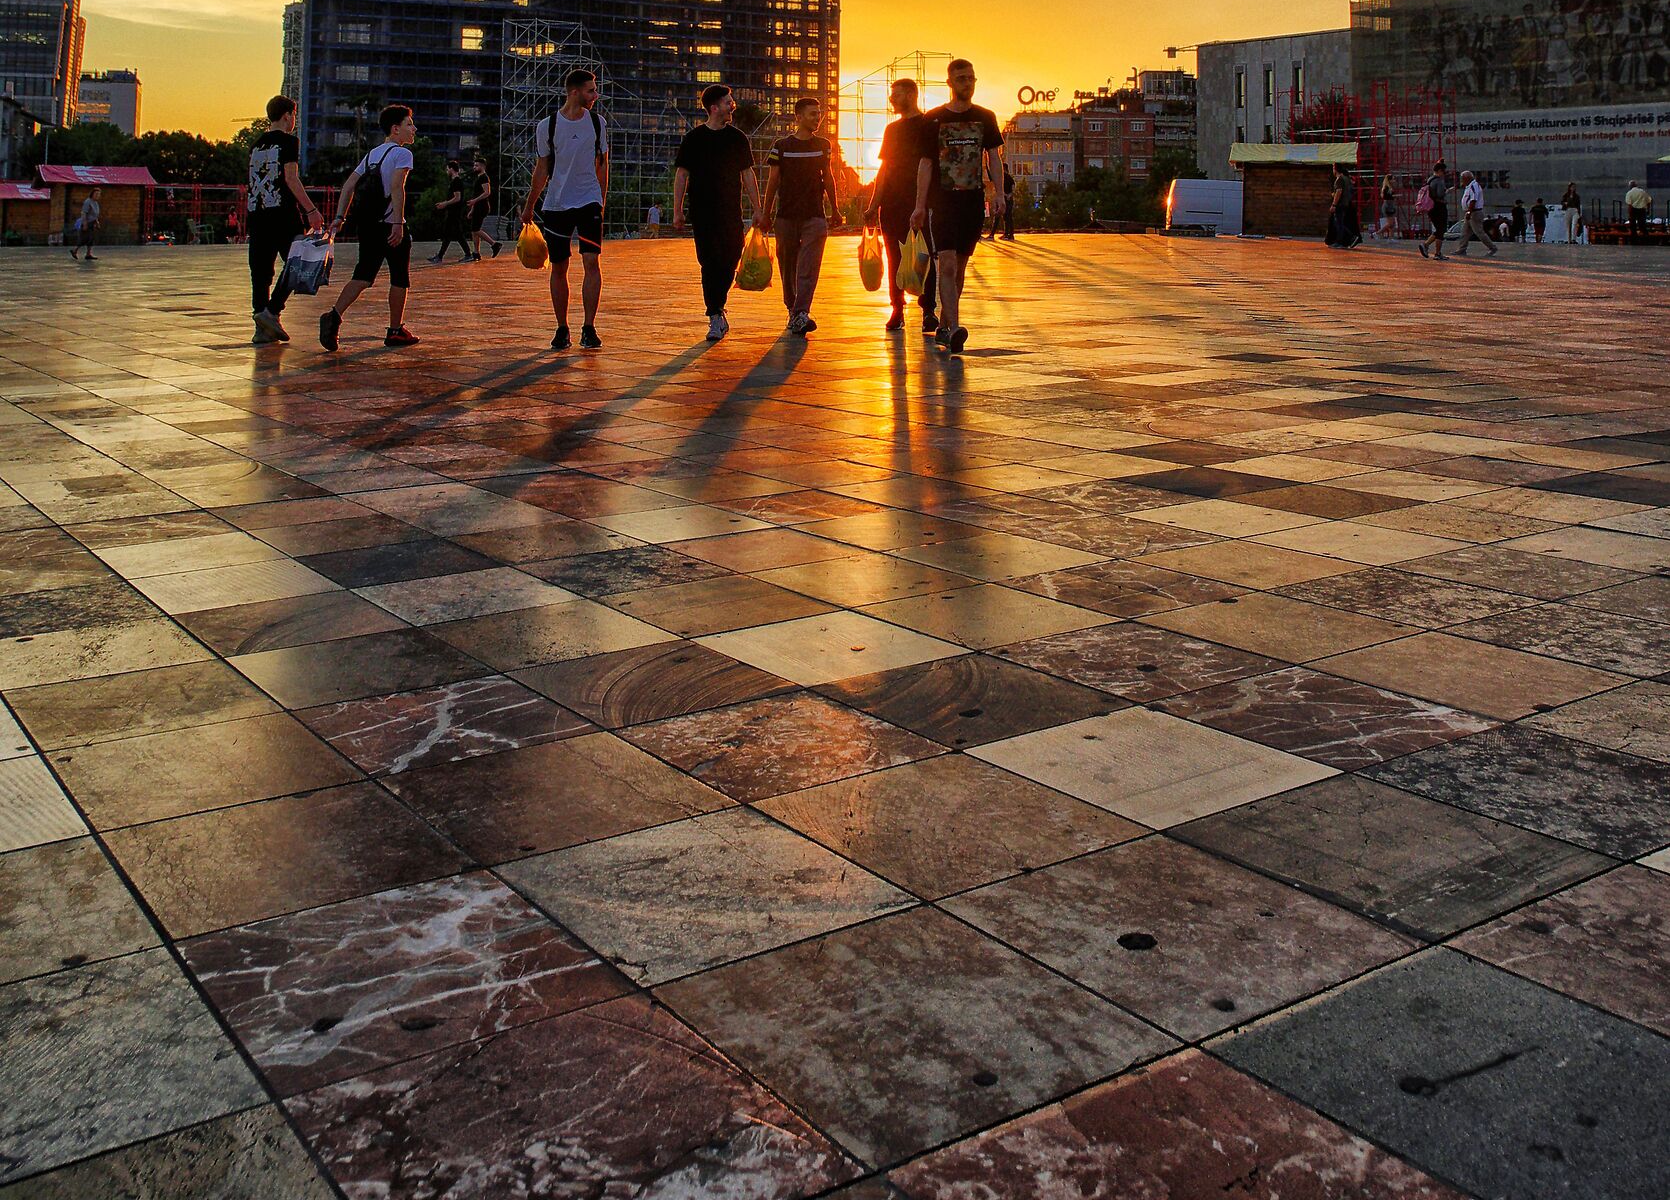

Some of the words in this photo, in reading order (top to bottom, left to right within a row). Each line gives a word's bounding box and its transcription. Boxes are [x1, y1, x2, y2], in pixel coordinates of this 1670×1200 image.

[1459, 119, 1527, 132] trashëgiminë
[1528, 116, 1578, 129] kulturore
[1580, 115, 1592, 126] të
[1593, 112, 1654, 127] Shqipërisë
[1481, 135, 1501, 144] back
[1503, 135, 1543, 143] Albania's
[1545, 132, 1579, 141] cultural
[1581, 131, 1620, 141] heritage
[1622, 130, 1636, 138] for
[1638, 129, 1655, 138] the
